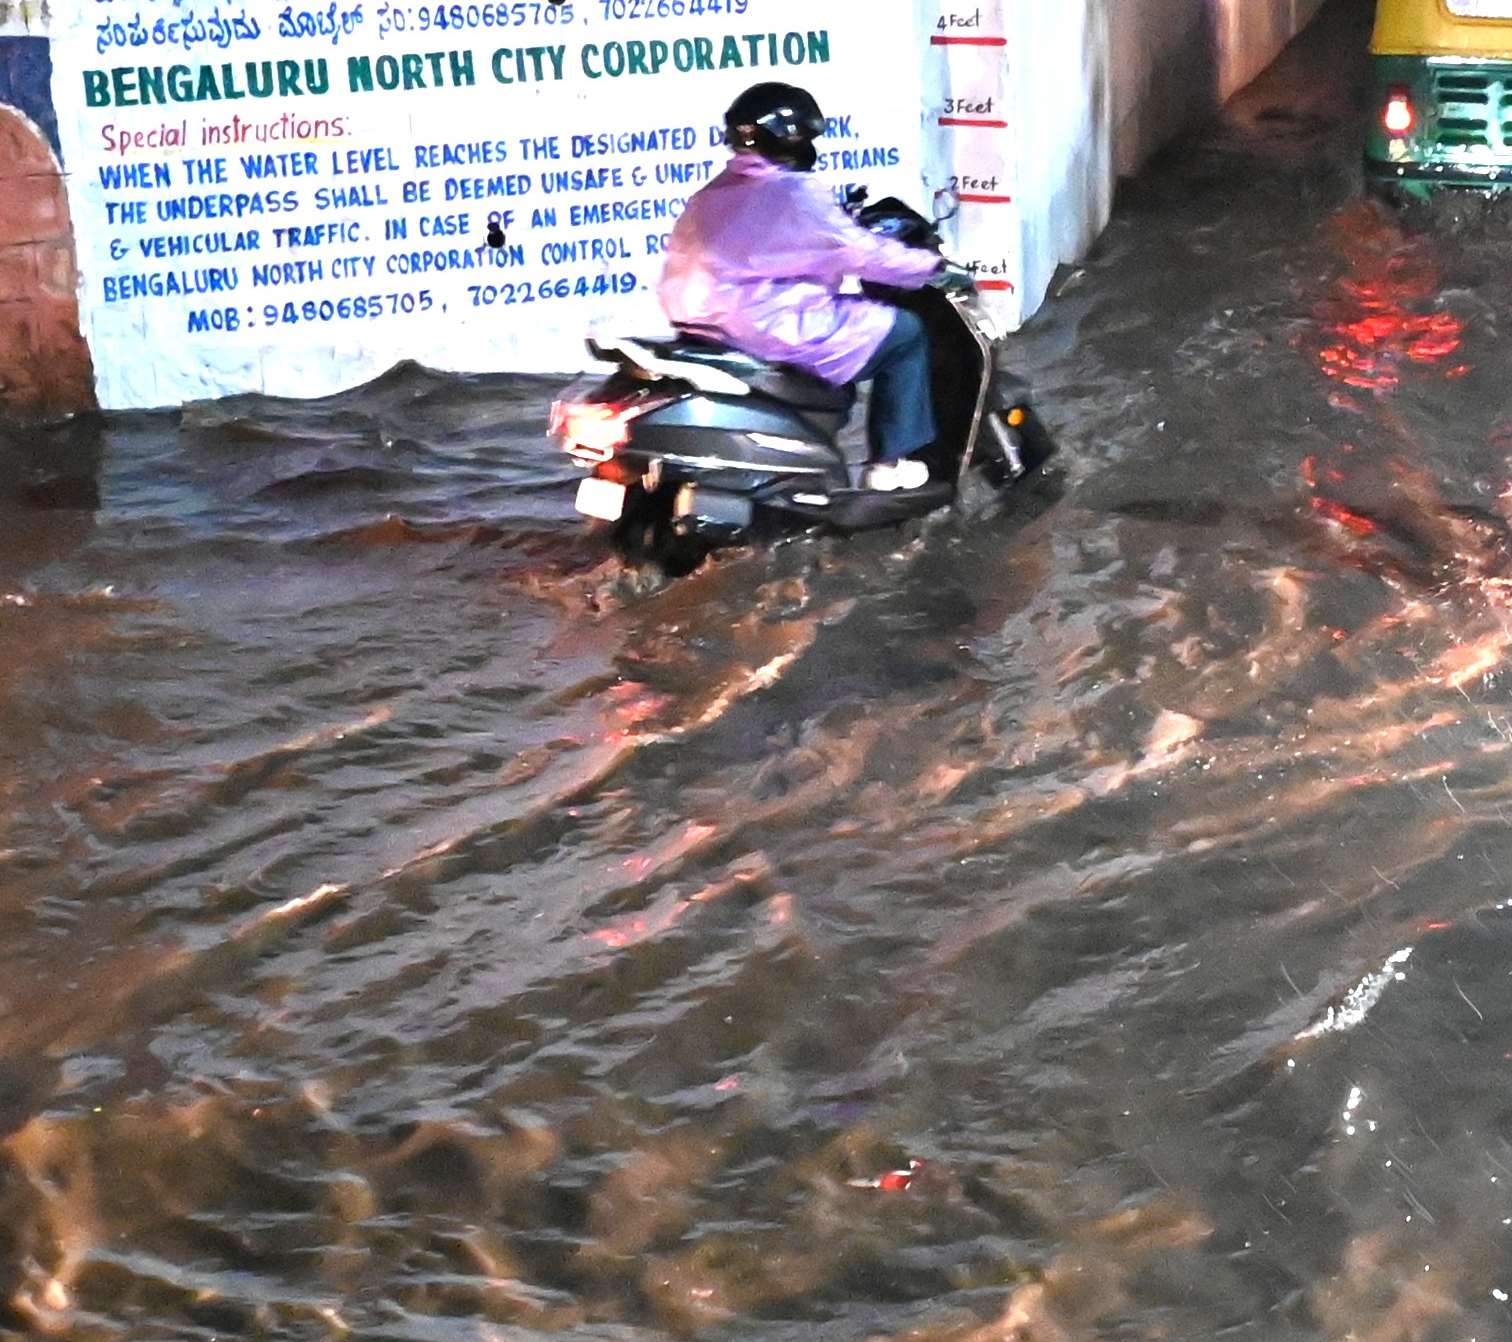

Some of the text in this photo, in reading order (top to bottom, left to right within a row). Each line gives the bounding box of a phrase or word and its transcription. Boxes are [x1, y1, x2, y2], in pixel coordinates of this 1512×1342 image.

[82, 29, 830, 108] BENGALURU NORTH CITY CORPORATION
[98, 162, 172, 190] WHEN
[182, 157, 228, 185] THE
[239, 151, 319, 180] WATER
[332, 147, 400, 175] LEVEL
[414, 140, 507, 168] REACHES
[519, 136, 561, 161] THE
[571, 126, 697, 159] DESIGNATED
[101, 114, 352, 156] Special instructions:
[105, 201, 148, 225] THE
[156, 190, 299, 222] UNDERPASS
[314, 184, 388, 211] SHALL
[402, 180, 431, 204] BE
[445, 170, 531, 201] DEEMED
[540, 167, 624, 194] UNSAFE
[631, 166, 648, 187] &
[655, 160, 714, 185] UNFIT
[109, 238, 130, 261] &
[138, 229, 261, 259] VEHICULAR
[272, 222, 369, 248] TRAFFIC.
[385, 217, 408, 241] IN
[419, 213, 470, 238] CASE
[487, 208, 515, 230] OF
[531, 207, 557, 229] AN
[102, 267, 239, 303] BENGALURU
[251, 259, 323, 287] NORTH
[331, 255, 376, 279] CITY
[386, 244, 525, 275] CORPORATION
[541, 237, 632, 266] CONTROL
